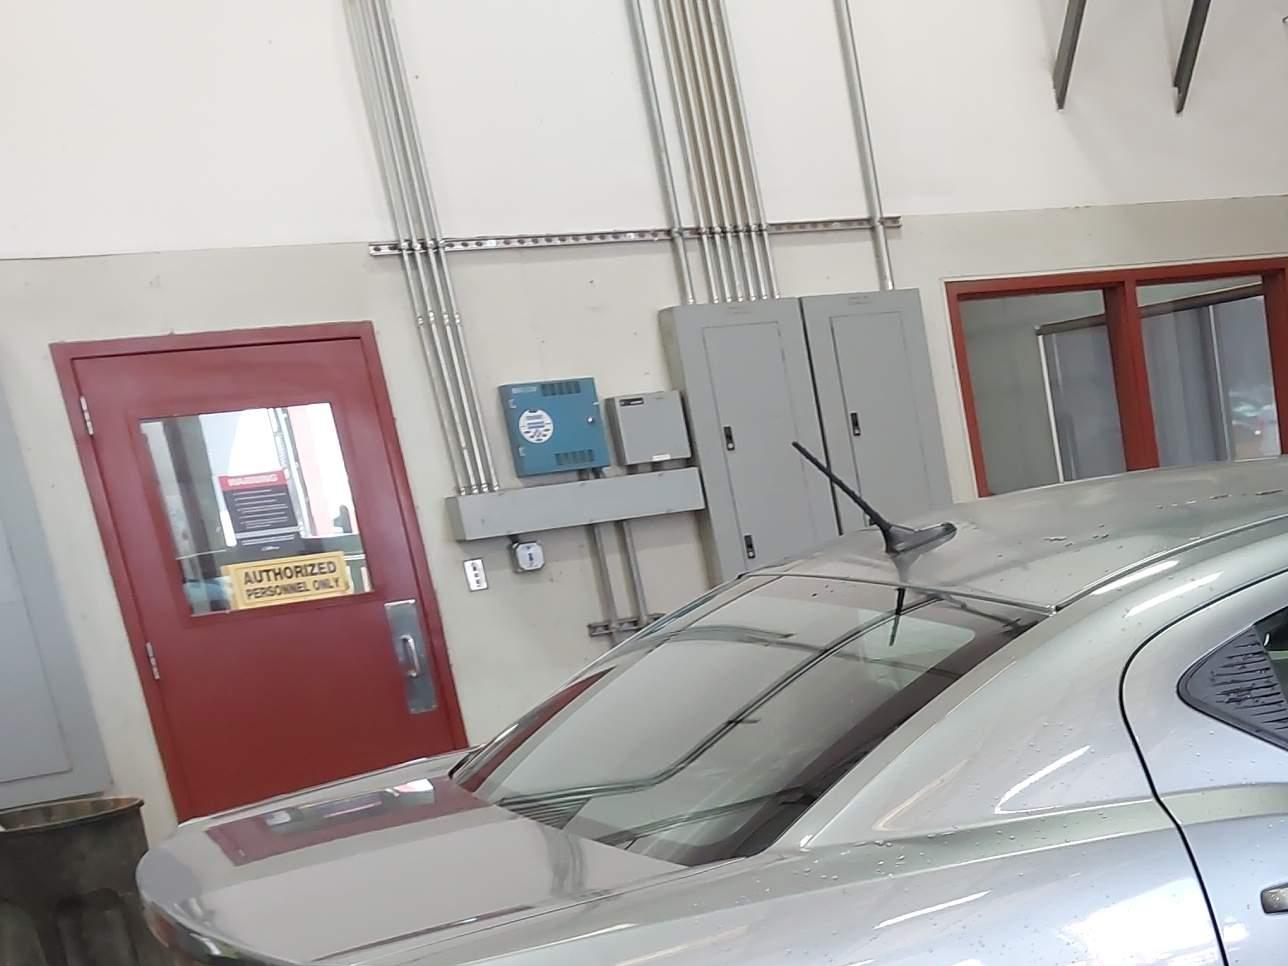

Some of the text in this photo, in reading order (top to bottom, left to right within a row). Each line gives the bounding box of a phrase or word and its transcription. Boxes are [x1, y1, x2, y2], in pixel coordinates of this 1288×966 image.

[243, 561, 337, 585] AUTHORIZED
[245, 576, 341, 600] PERSONNEL ONLY
